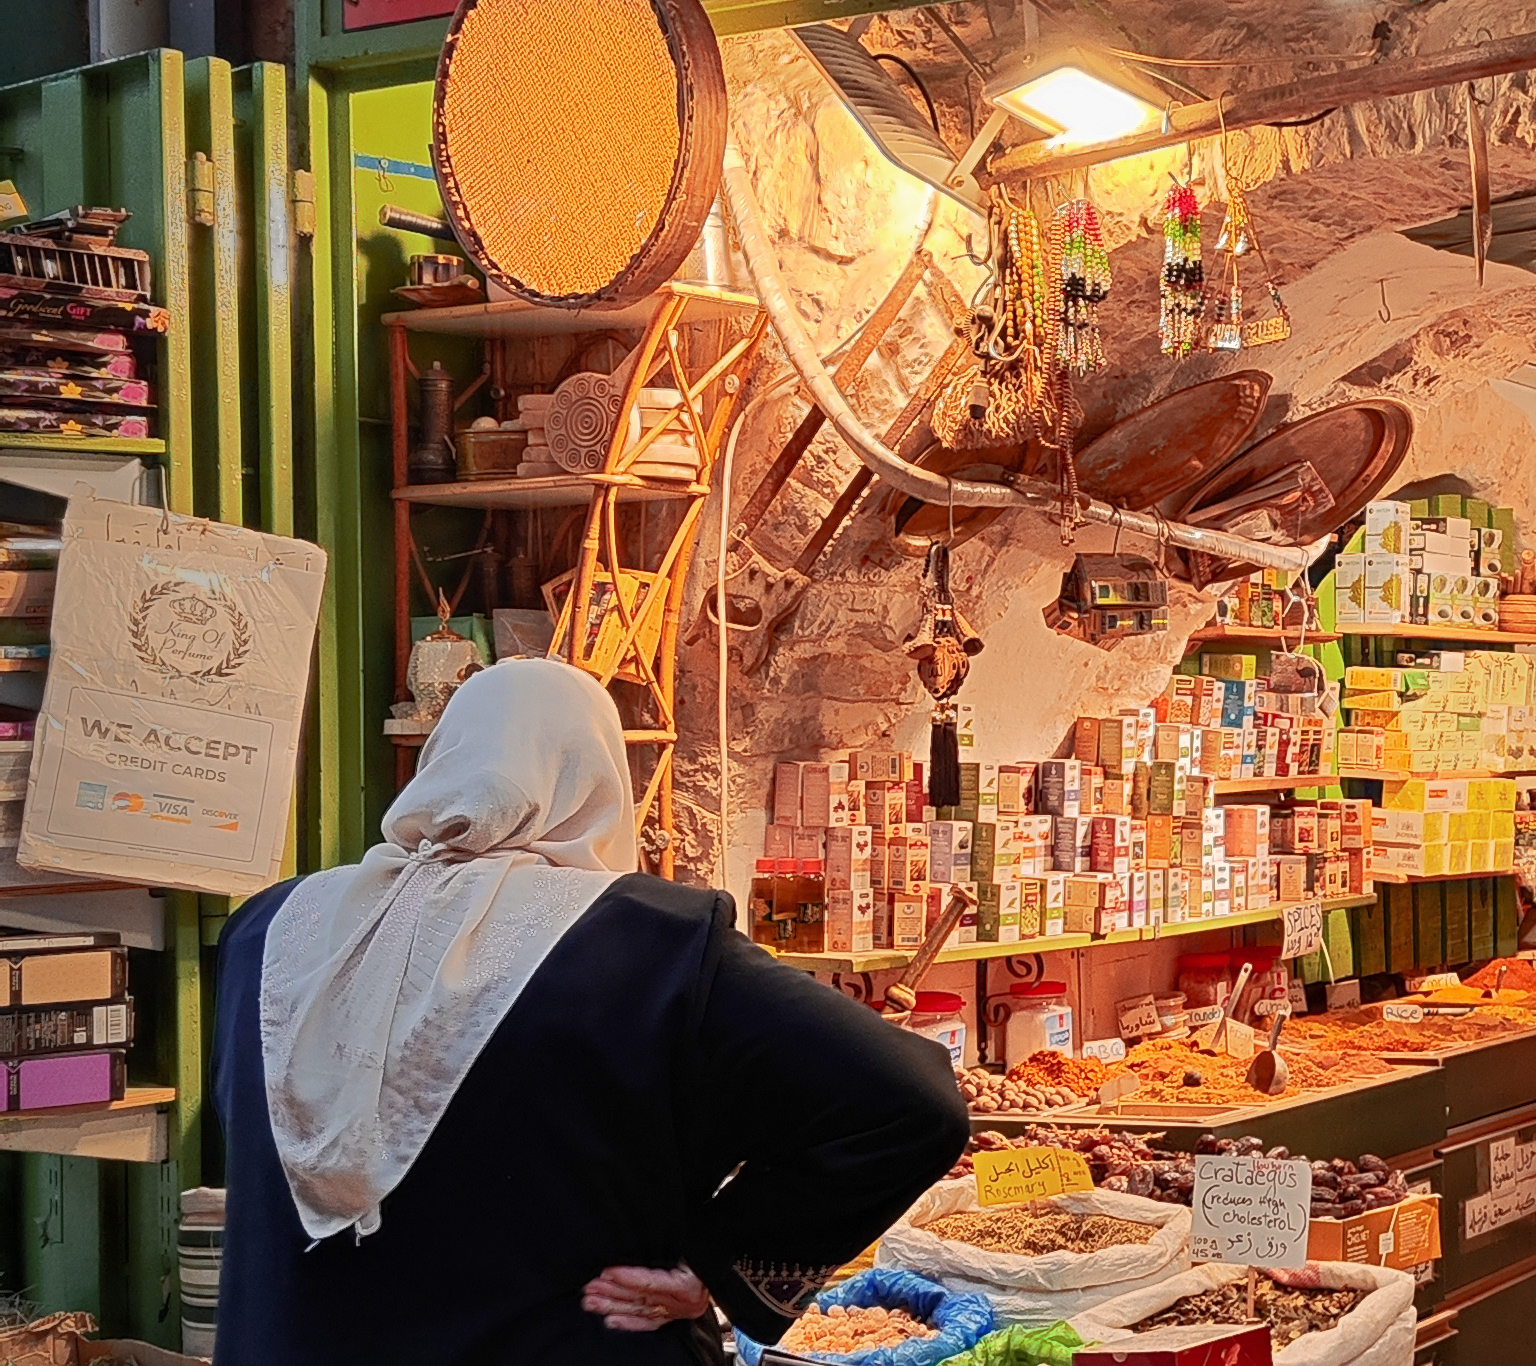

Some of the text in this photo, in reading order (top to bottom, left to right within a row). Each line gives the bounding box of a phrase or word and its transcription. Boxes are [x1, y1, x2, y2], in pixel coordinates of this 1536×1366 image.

[154, 620, 226, 649] King Of
[158, 636, 214, 663] Perfume
[80, 715, 258, 766] WE ACCEPT
[104, 751, 227, 784] CREDIT CARDS
[156, 802, 190, 818] VISA
[983, 1180, 1047, 1200] Rosemary
